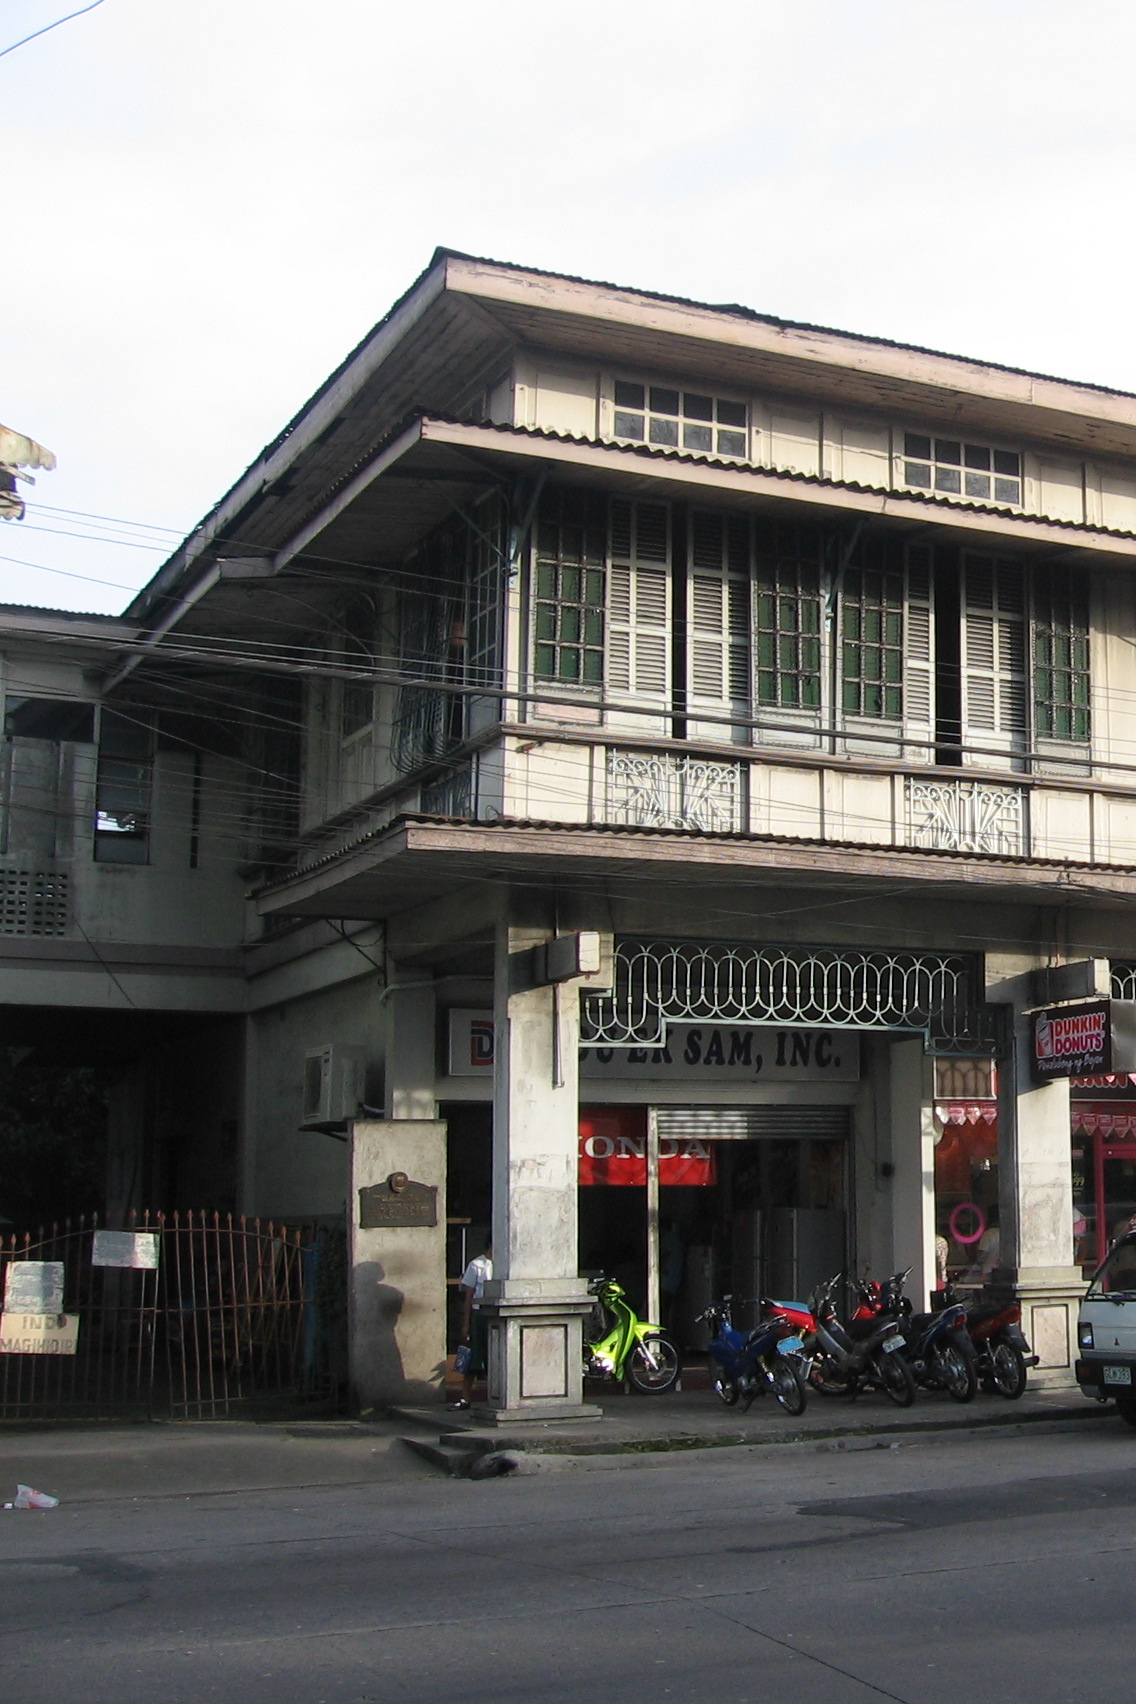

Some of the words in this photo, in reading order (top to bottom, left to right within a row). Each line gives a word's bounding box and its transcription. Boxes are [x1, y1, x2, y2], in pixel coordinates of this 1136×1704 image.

[1054, 1012, 1106, 1037] DUNKIN'
[683, 1030, 763, 1073] SAM,
[776, 1031, 842, 1068] INC.
[1054, 1032, 1104, 1056] DONUTS
[578, 1135, 711, 1159] ONDA
